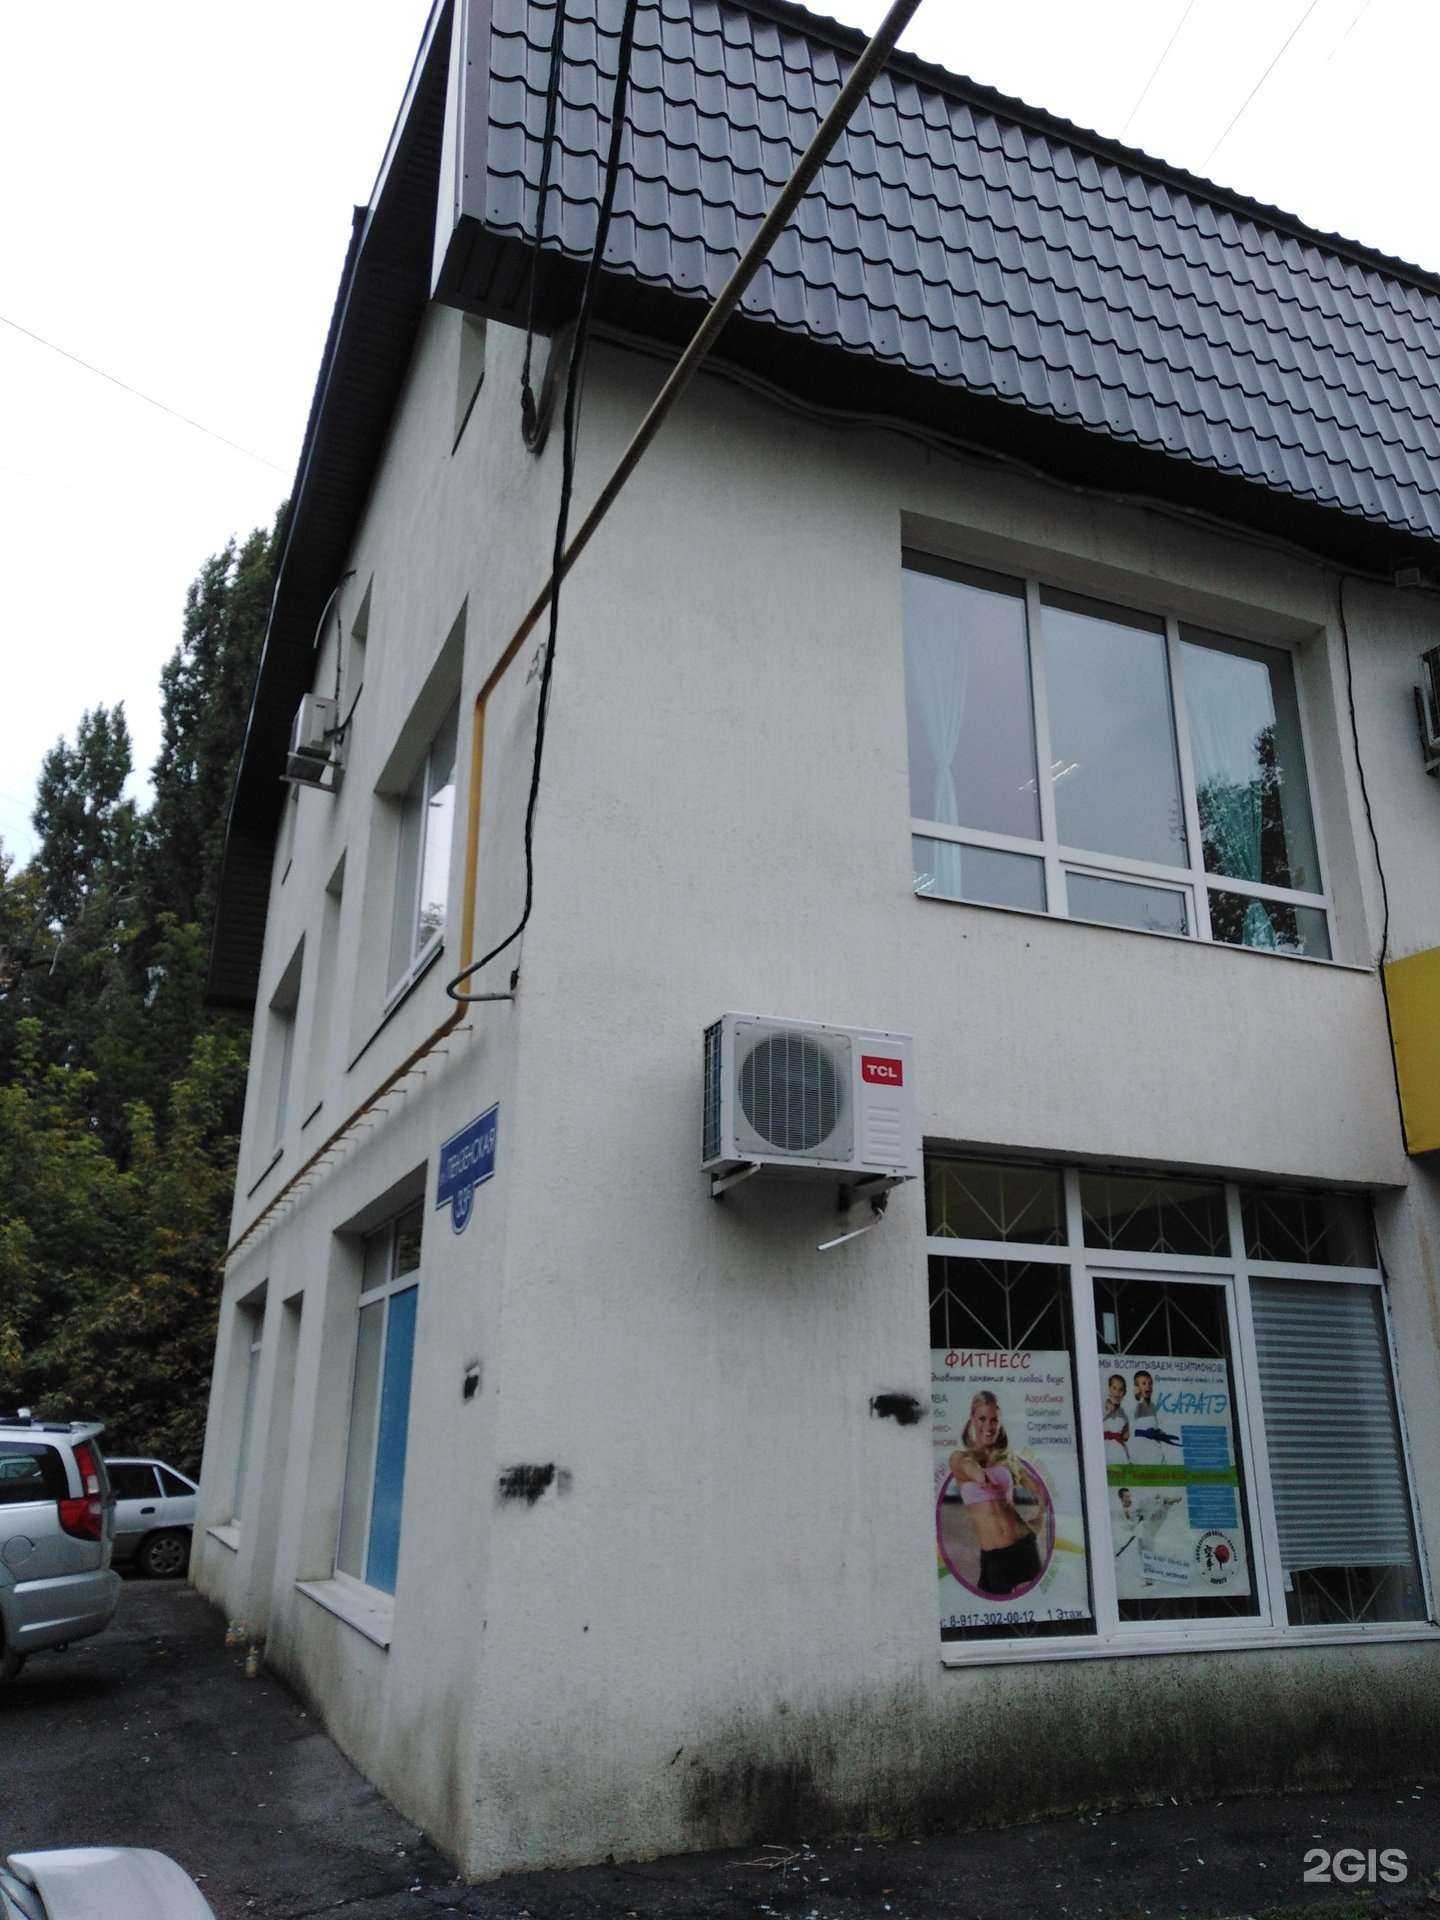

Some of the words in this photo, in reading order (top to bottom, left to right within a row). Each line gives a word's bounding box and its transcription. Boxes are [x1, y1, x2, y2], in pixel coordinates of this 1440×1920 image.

[867, 1064, 898, 1078] TCL
[944, 1350, 1032, 1369] ФИТНЕСС
[1115, 1359, 1172, 1371] ВОСПИТЫВАЕМ
[1156, 1392, 1228, 1415] КАРАТЭ
[950, 1610, 1035, 1627] 8-917-302-00-12
[1056, 1608, 1084, 1620] Этаж
